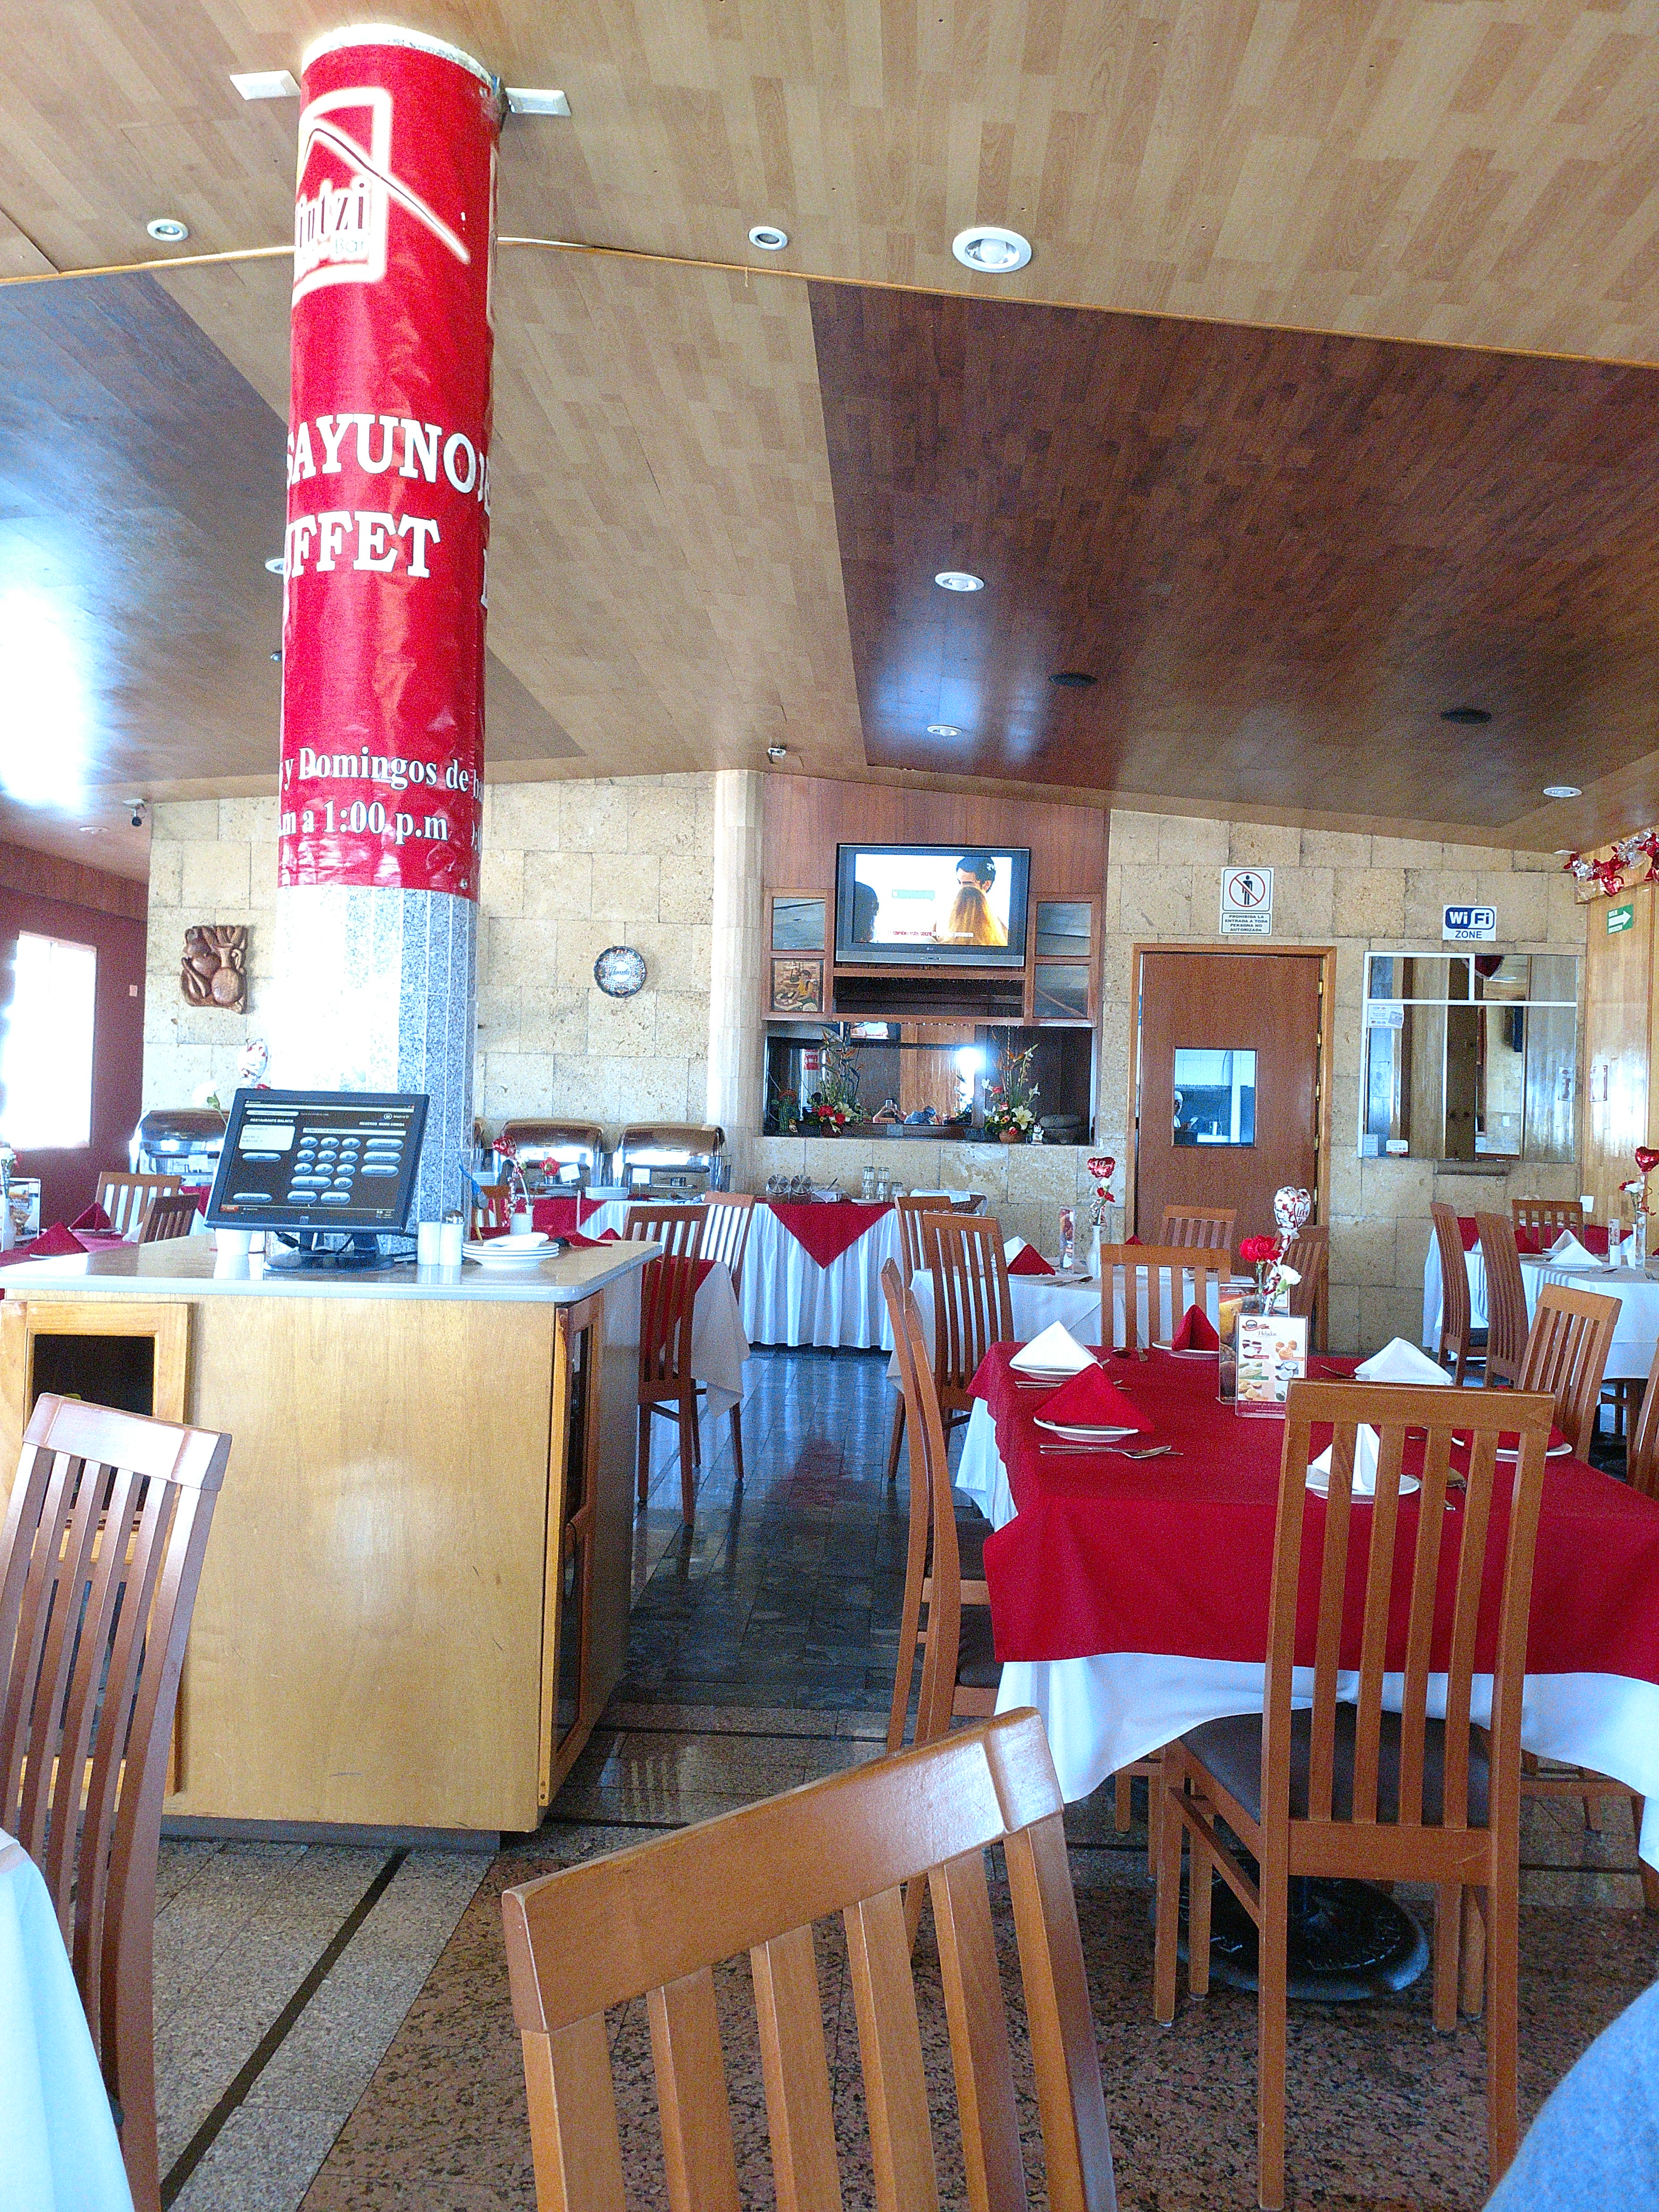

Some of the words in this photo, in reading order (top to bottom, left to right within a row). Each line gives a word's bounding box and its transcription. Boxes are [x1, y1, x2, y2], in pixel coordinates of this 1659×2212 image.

[299, 746, 437, 790] Domingos
[446, 758, 470, 792] de
[302, 809, 315, 834] a
[323, 800, 387, 834] 1:00
[395, 811, 448, 845] p.m
[1455, 930, 1482, 939] ZONE
